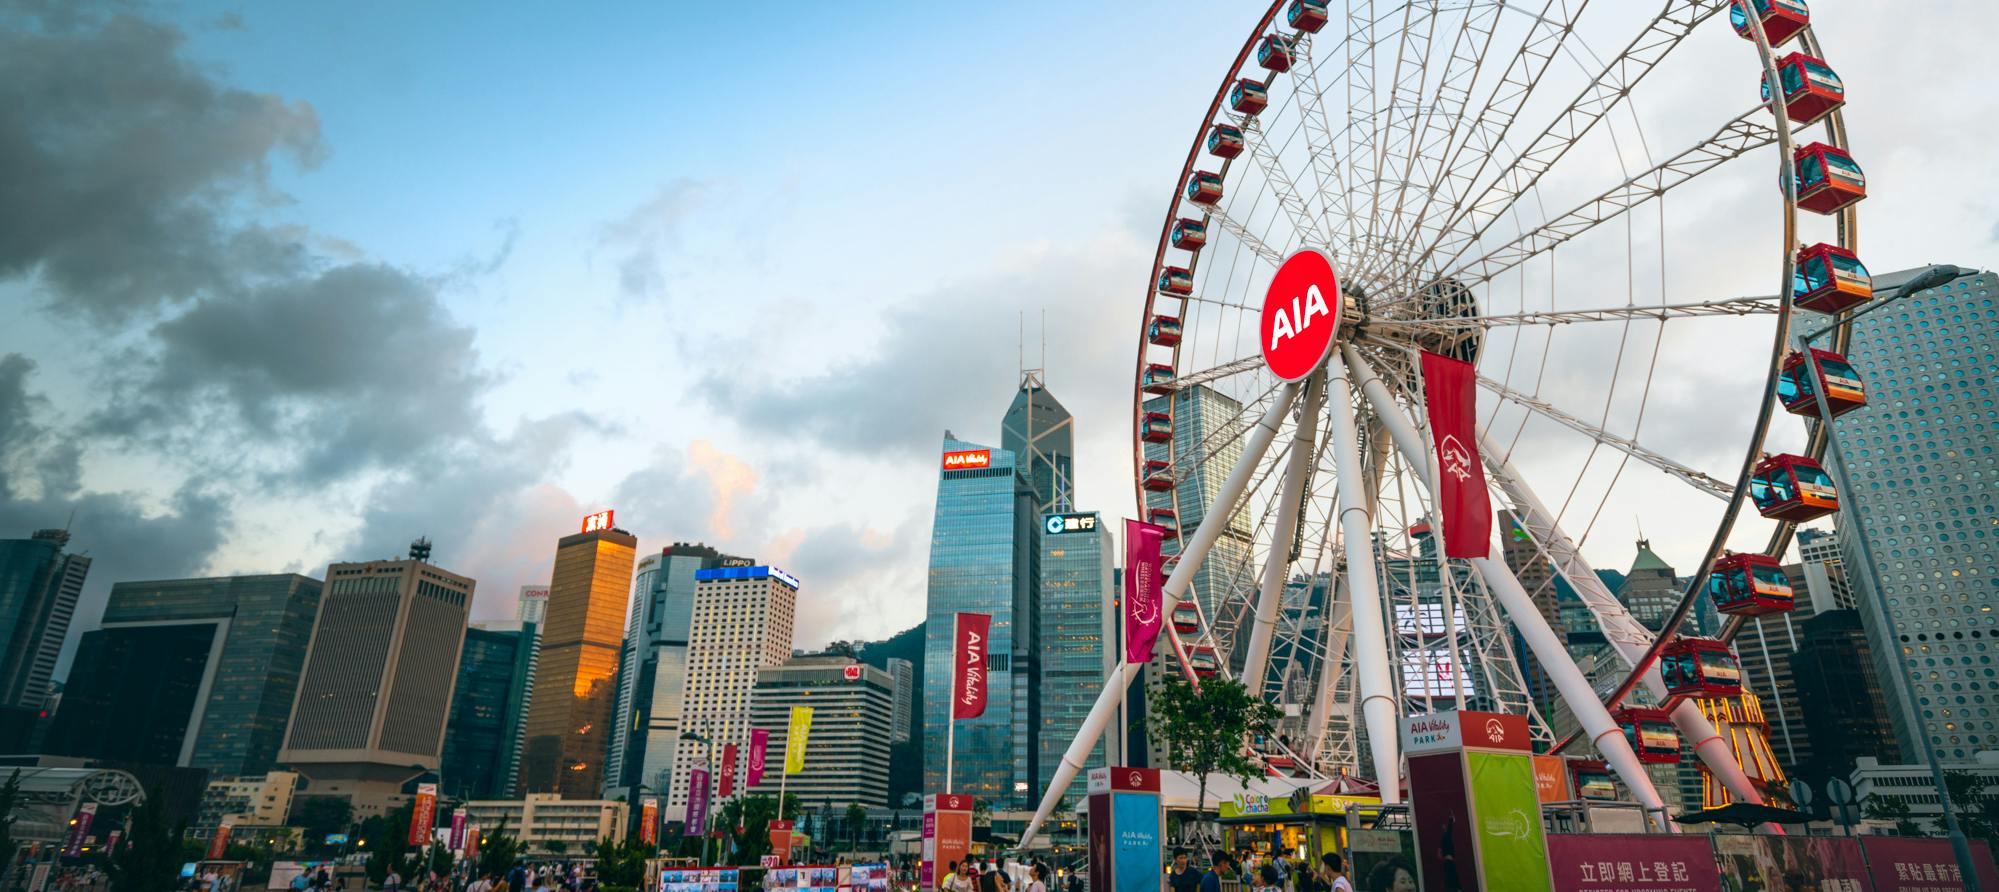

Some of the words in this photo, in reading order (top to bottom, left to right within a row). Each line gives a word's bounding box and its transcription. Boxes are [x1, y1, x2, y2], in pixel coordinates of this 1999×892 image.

[1271, 284, 1329, 352] AIA
[945, 455, 965, 465] AIA
[1064, 516, 1095, 530] 建行
[723, 559, 751, 567] LIPPO
[525, 590, 549, 598] CONR
[968, 631, 981, 665] AIA
[961, 667, 982, 706] Vitality
[1410, 721, 1428, 734] AIA
[1428, 719, 1450, 733] Vitality
[1413, 735, 1436, 745] PARK
[1489, 734, 1504, 743] AIA
[1122, 831, 1136, 839] AIA
[1579, 861, 1689, 883] 立即網上登記
[1894, 862, 1963, 882] 緊貼最新消
